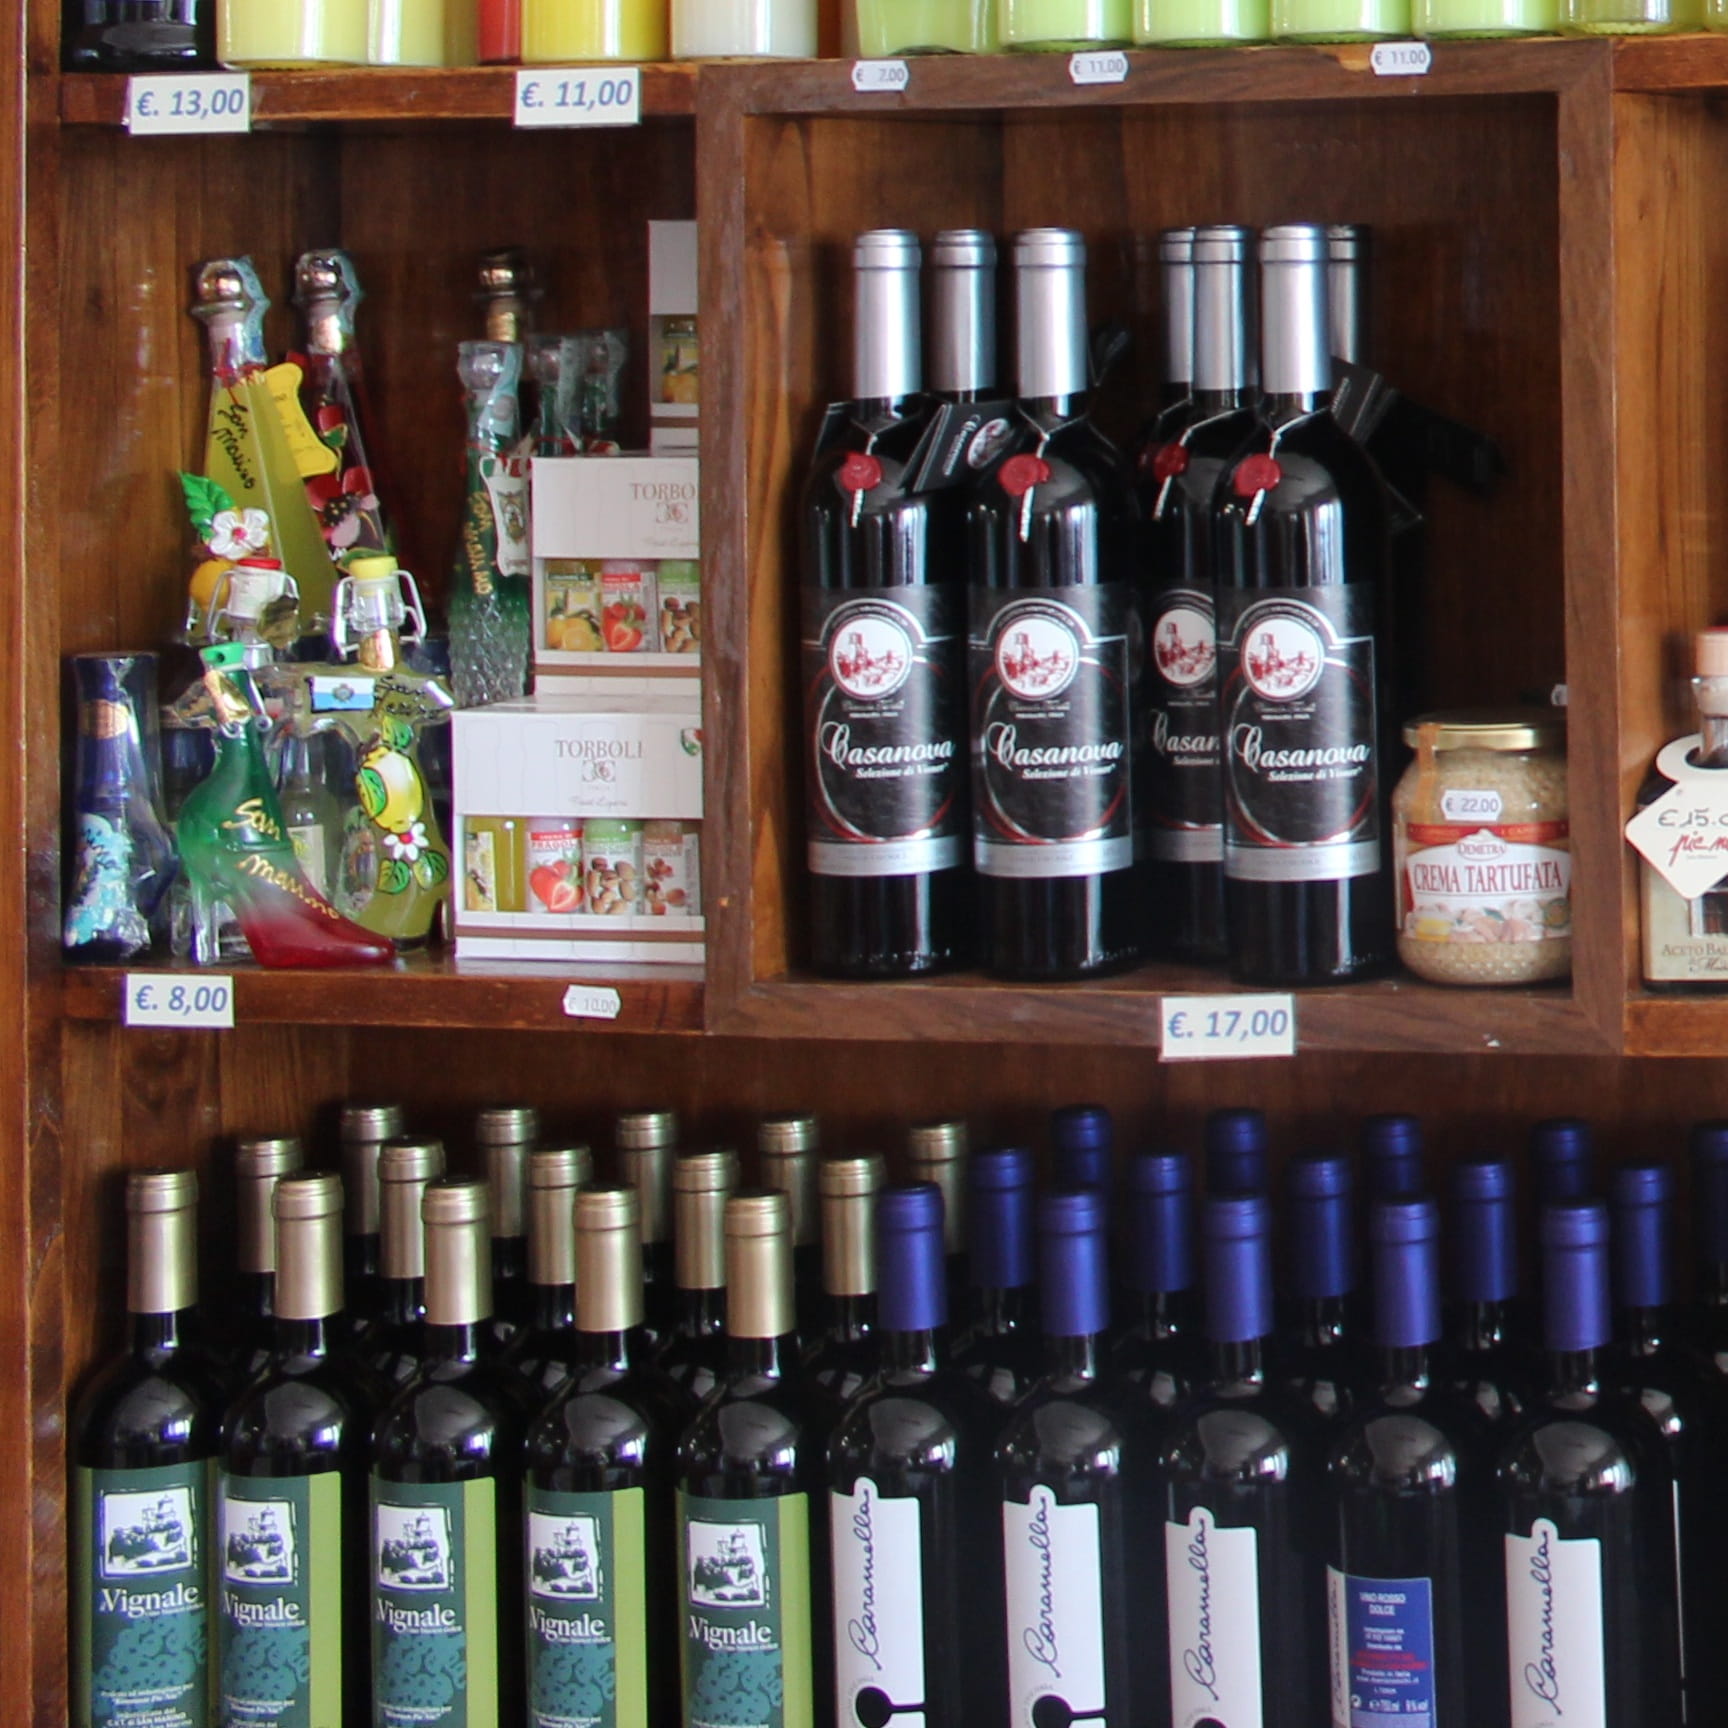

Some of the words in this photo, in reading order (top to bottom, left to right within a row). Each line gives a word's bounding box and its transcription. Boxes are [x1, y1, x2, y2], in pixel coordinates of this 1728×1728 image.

[171, 88, 244, 118] 13,00
[556, 79, 632, 108] 11,00
[555, 739, 643, 759] TORBOLI
[987, 721, 1124, 774] Casanova
[1413, 865, 1459, 892] CREMA
[1463, 863, 1563, 892] TARTUFATA
[168, 985, 228, 1014] 8,00
[1204, 1009, 1288, 1039] 17,00
[99, 1583, 201, 1616] Vignale
[1022, 1494, 1062, 1680] Caramella
[688, 1618, 772, 1648] Vignale
